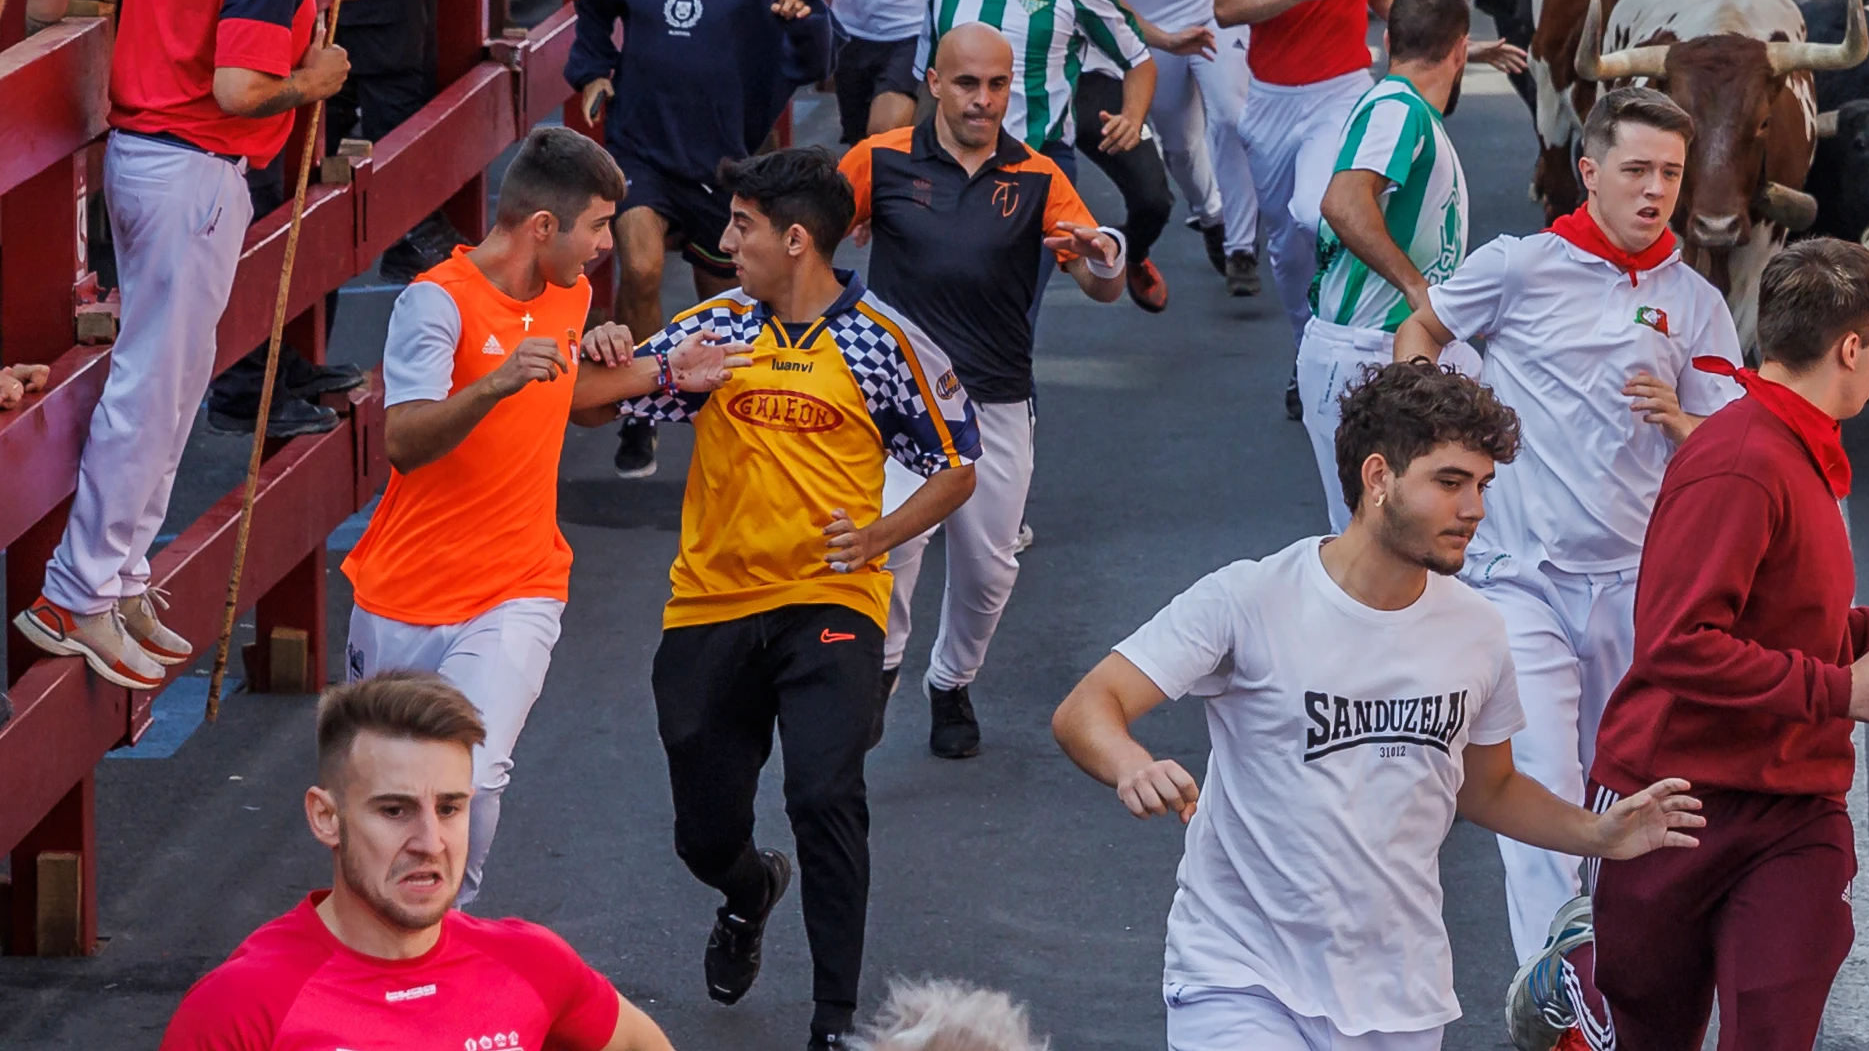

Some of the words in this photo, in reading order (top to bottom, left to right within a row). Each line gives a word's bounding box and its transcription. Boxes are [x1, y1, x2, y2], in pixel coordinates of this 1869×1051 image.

[771, 357, 814, 373] luanvi
[1304, 689, 1468, 750] SANDUZELAI
[1380, 745, 1406, 758] 31012
